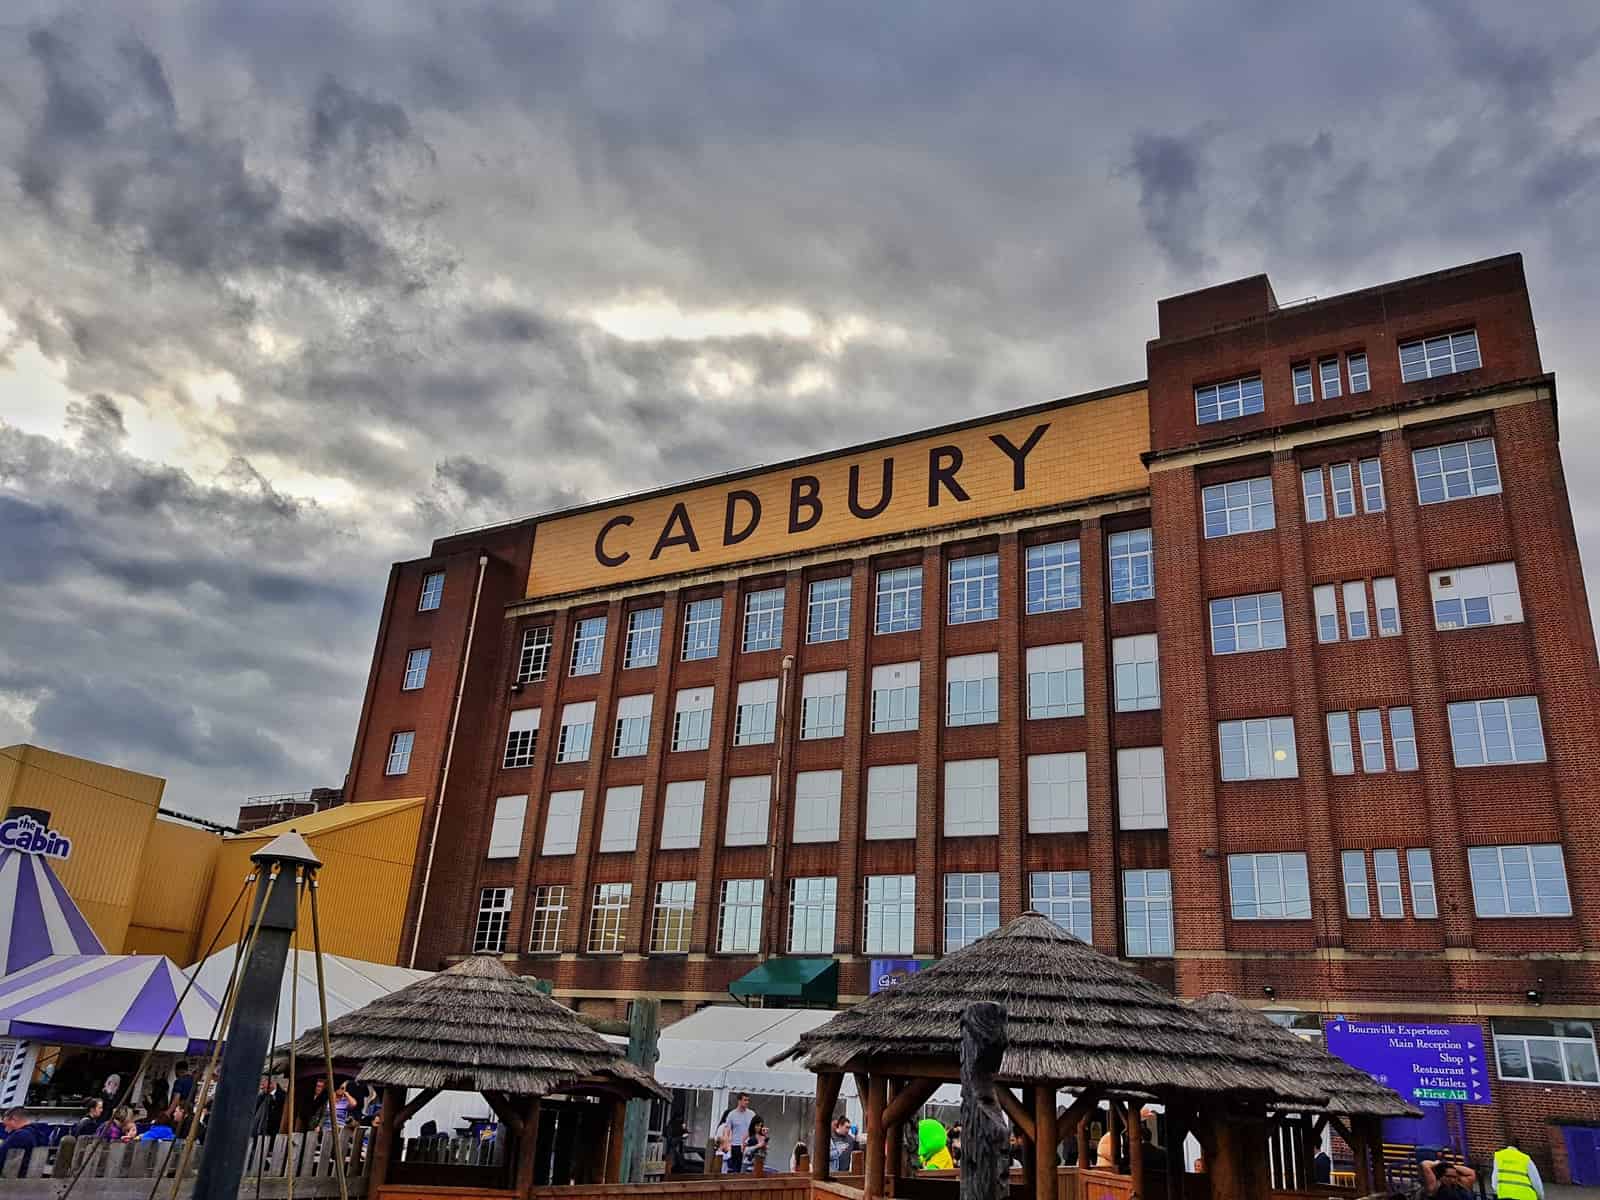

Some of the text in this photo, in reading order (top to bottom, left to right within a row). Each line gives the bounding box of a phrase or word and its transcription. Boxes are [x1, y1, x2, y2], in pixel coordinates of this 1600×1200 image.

[594, 423, 1052, 567] CADBURY
[19, 818, 36, 831] the
[0, 822, 70, 857] Cabin
[1348, 1024, 1450, 1037] Bournville Experience
[1389, 1038, 1462, 1051] Main Reception
[1439, 1053, 1464, 1065] Shop
[1412, 1064, 1465, 1075] Restaurant
[1438, 1078, 1467, 1088] Toilets
[1423, 1089, 1468, 1100] First Aid
